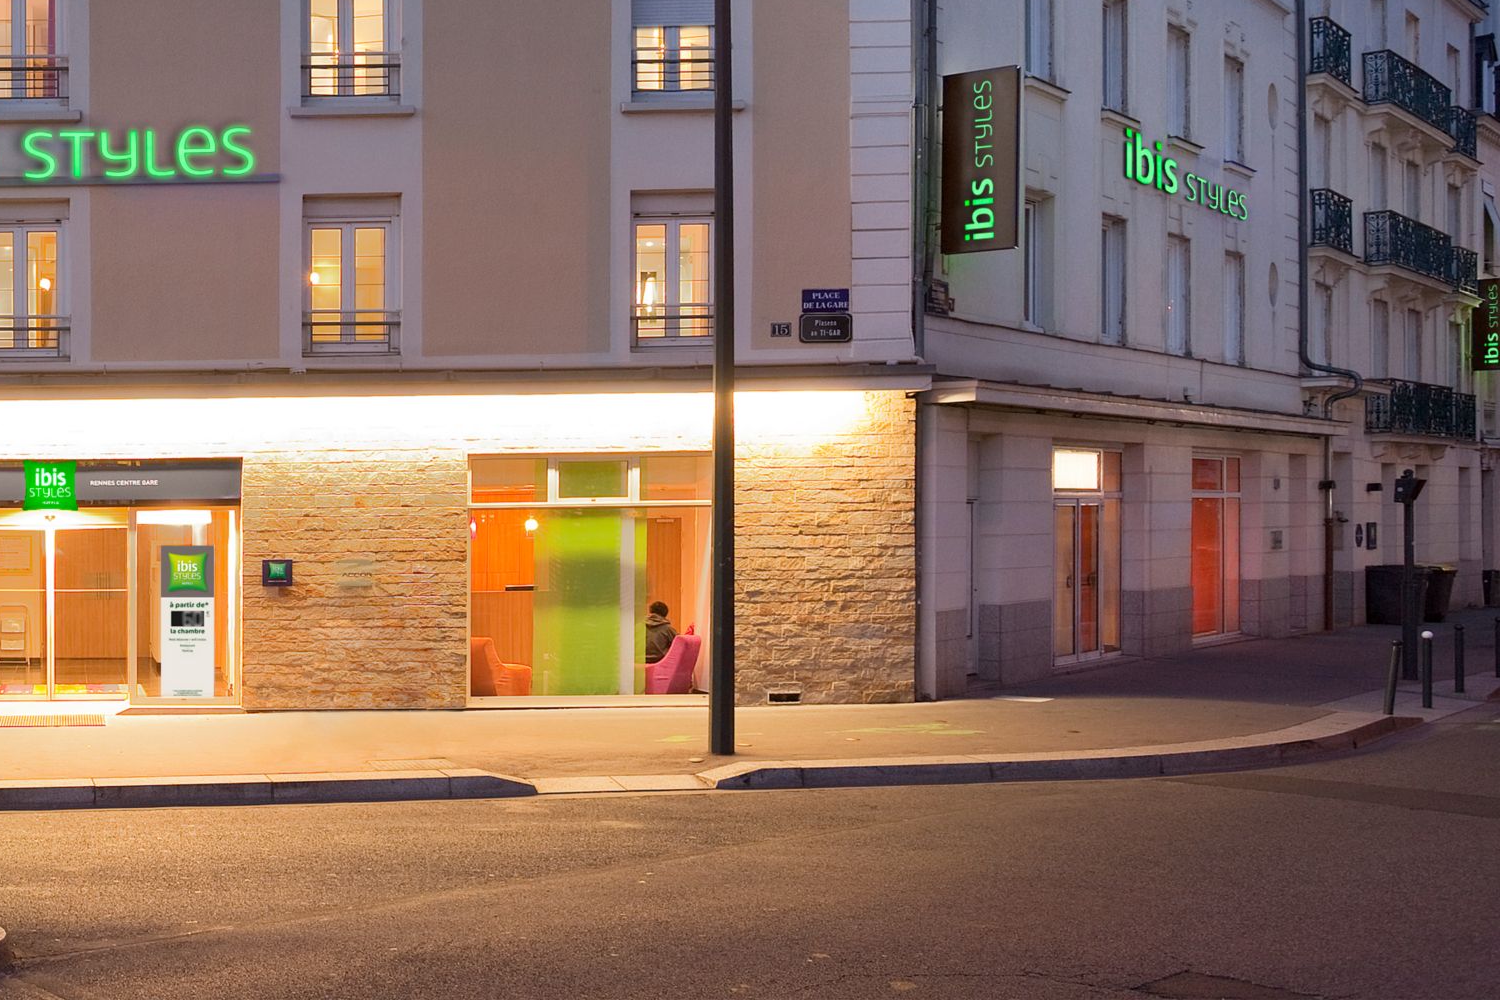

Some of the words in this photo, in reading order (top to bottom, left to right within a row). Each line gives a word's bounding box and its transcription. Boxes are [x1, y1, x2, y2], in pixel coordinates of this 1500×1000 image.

[1124, 127, 1179, 195] ibis
[964, 178, 995, 242] ibis
[816, 301, 826, 309] LA
[827, 301, 849, 309] GARE
[774, 325, 789, 336] 15
[1484, 332, 1500, 364] ibis
[35, 468, 67, 487] ibis
[90, 479, 115, 487] RENNES
[116, 479, 141, 487] CENTRE
[177, 560, 198, 573] ibis
